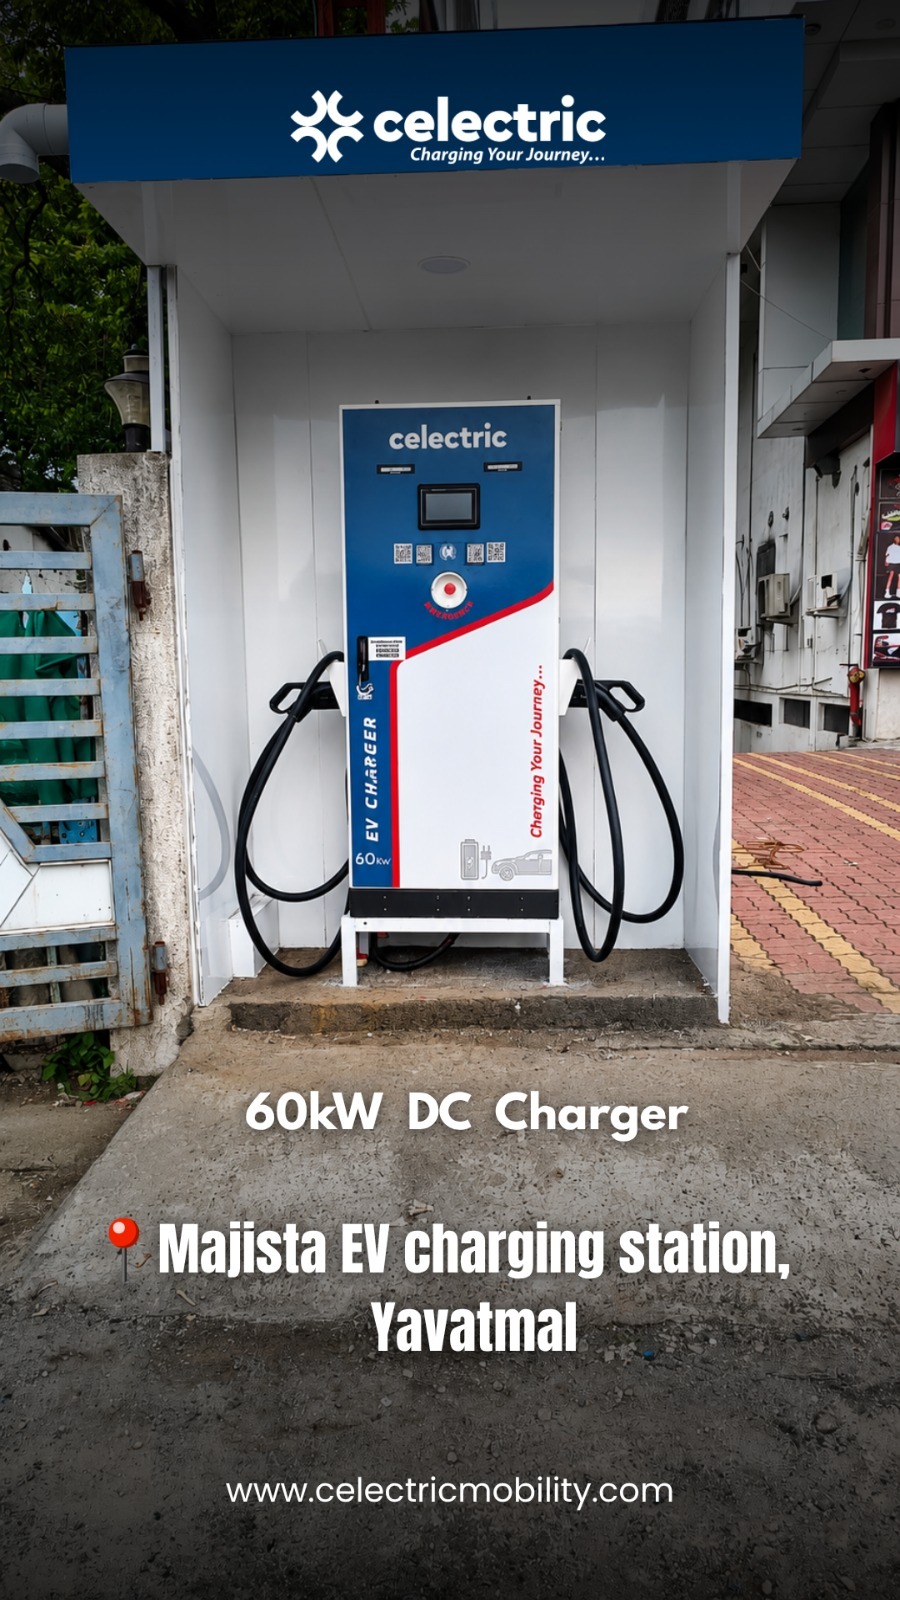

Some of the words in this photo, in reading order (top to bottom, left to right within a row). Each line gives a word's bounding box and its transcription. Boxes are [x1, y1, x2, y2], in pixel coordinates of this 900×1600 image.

[373, 94, 607, 143] celectric
[410, 146, 484, 165] Charging
[487, 147, 525, 162] Your
[526, 147, 605, 165] Journey...
[389, 422, 507, 450] celectric
[530, 665, 545, 737] Journey...
[530, 739, 542, 772] Your
[365, 817, 379, 842] EV
